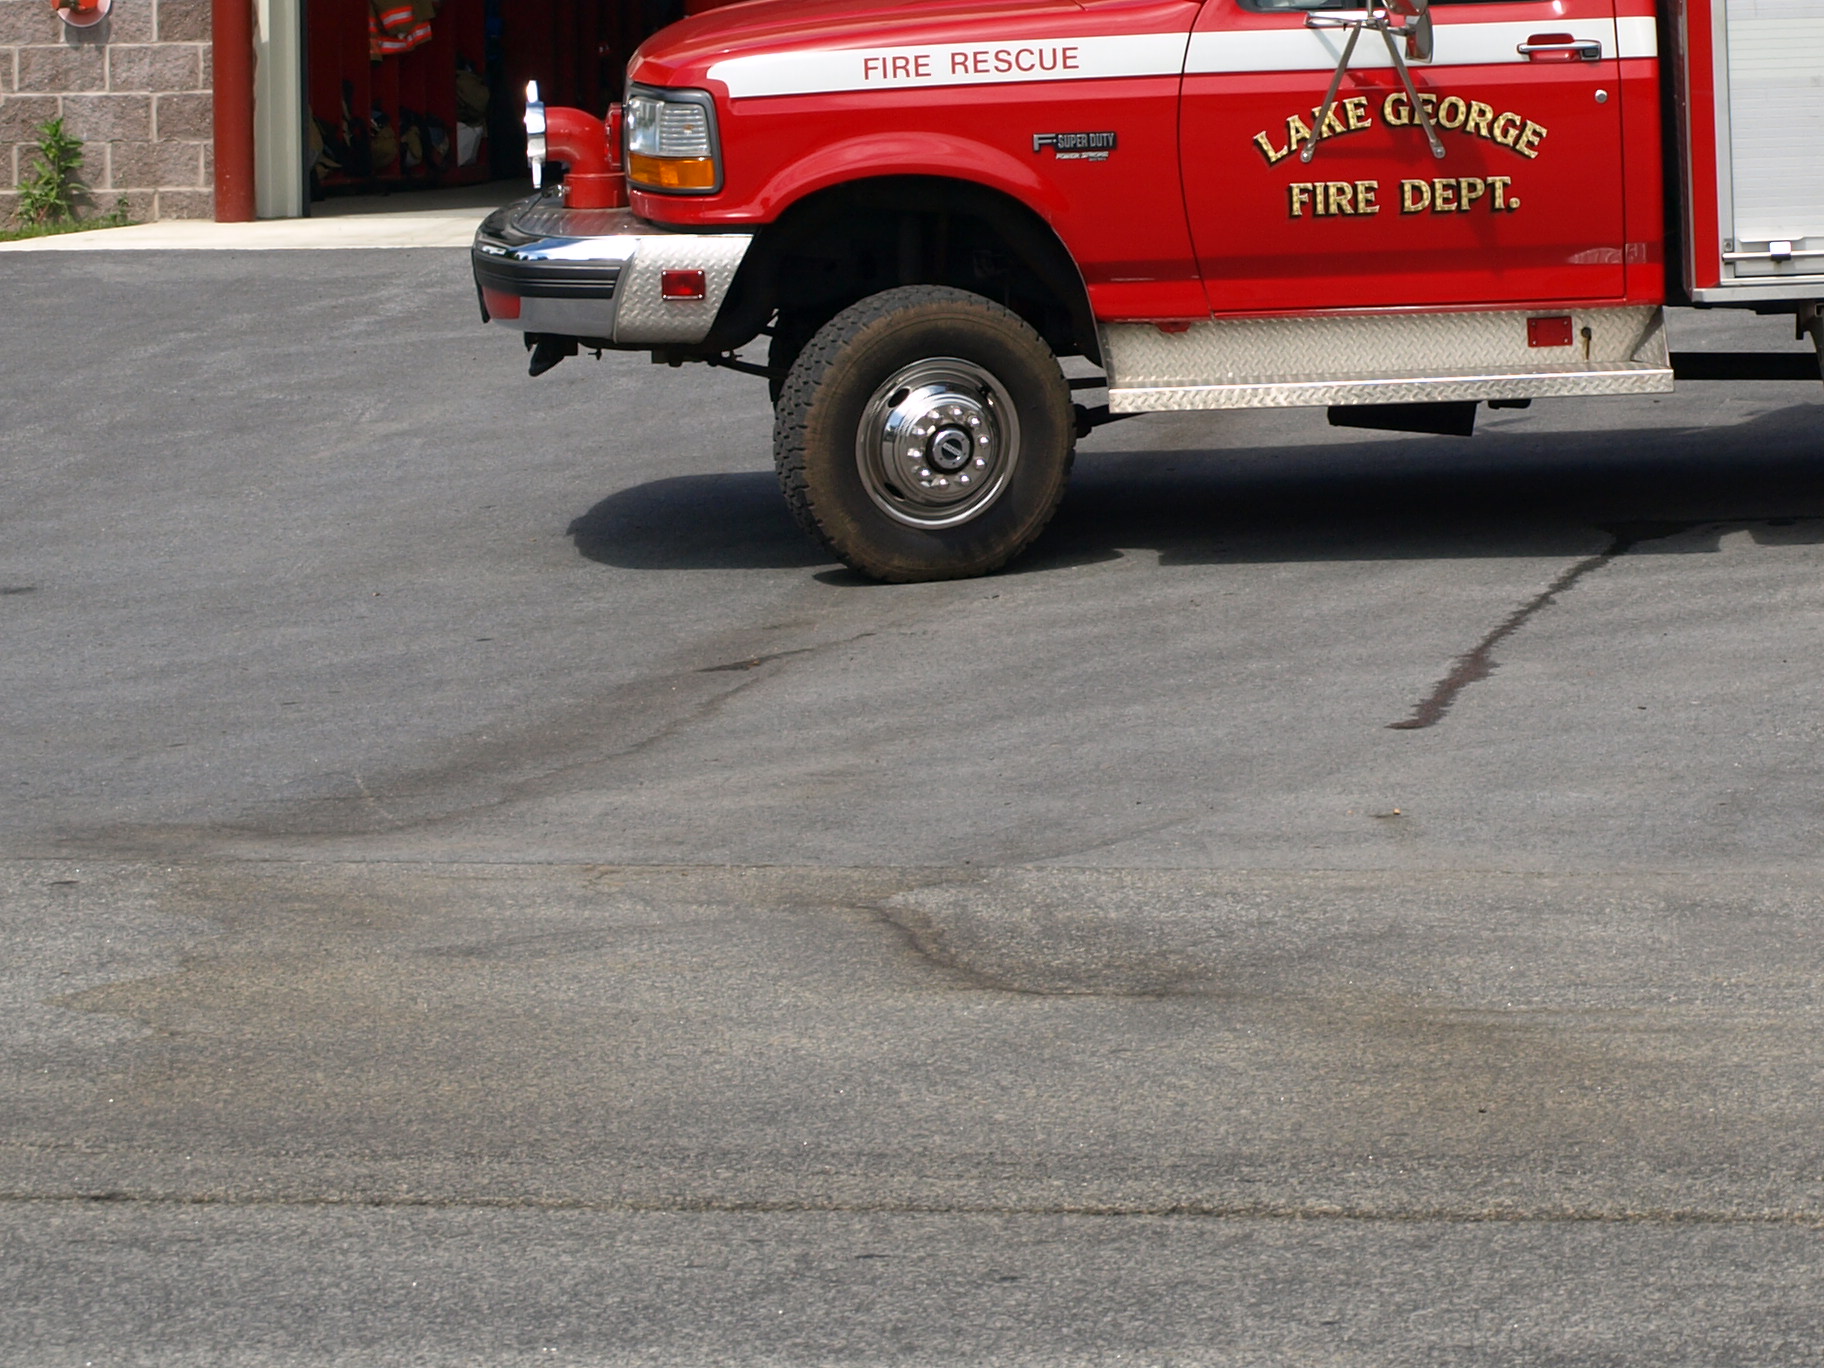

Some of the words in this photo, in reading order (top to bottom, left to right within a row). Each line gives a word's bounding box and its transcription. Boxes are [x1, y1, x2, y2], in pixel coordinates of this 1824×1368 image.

[863, 54, 932, 81] FIRE
[950, 46, 1080, 75] RESCUE
[1253, 96, 1373, 165] LAKE
[1383, 92, 1548, 159] GEORGE
[1289, 180, 1381, 217] FIRE
[1400, 176, 1521, 214] DEPT.
